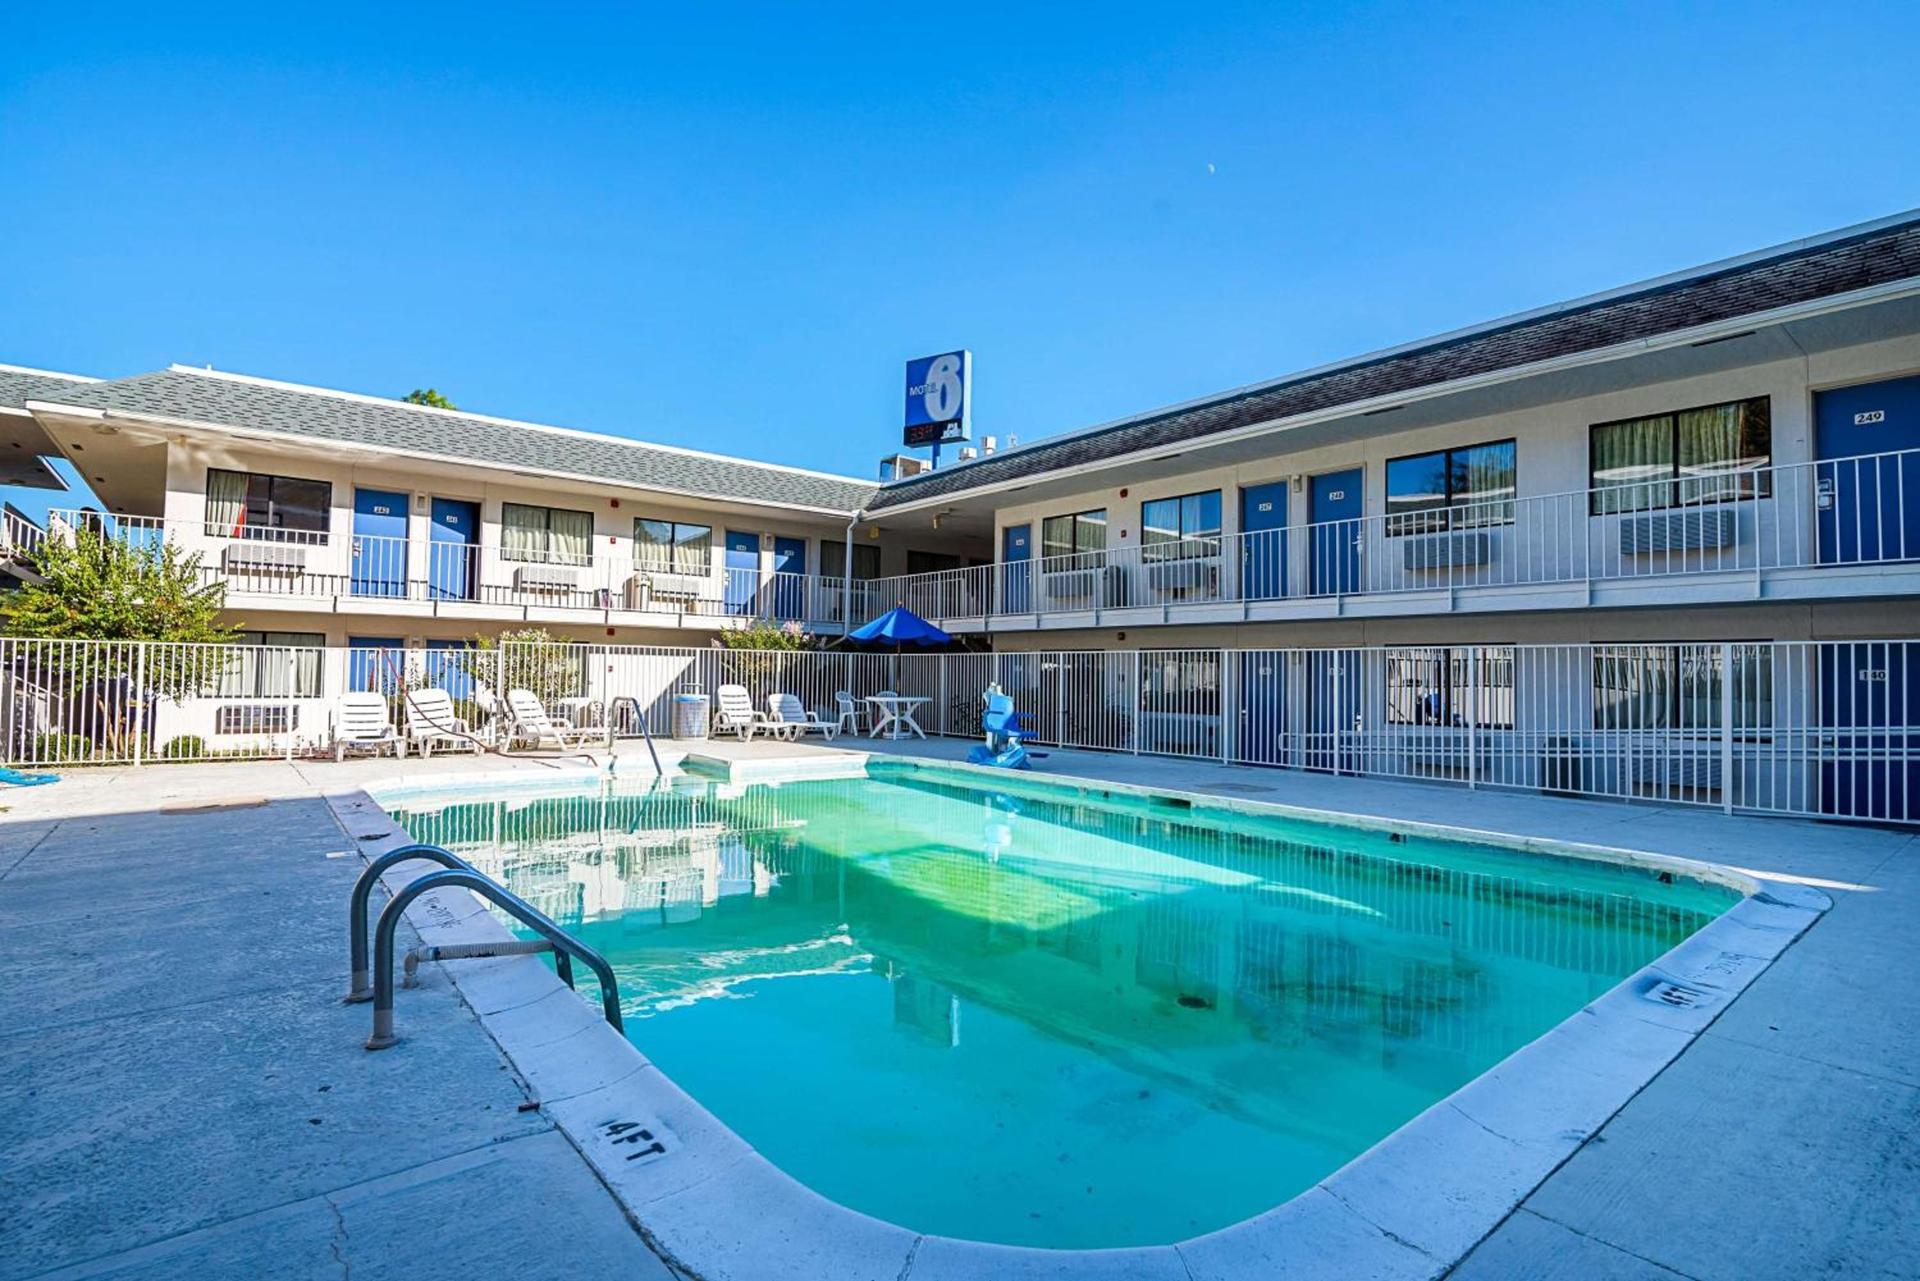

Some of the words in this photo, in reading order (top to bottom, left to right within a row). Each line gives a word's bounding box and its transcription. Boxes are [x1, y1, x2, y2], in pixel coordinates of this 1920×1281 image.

[909, 384, 938, 396] MOTEL
[925, 354, 962, 421] 6
[605, 1122, 666, 1161] 4FT
